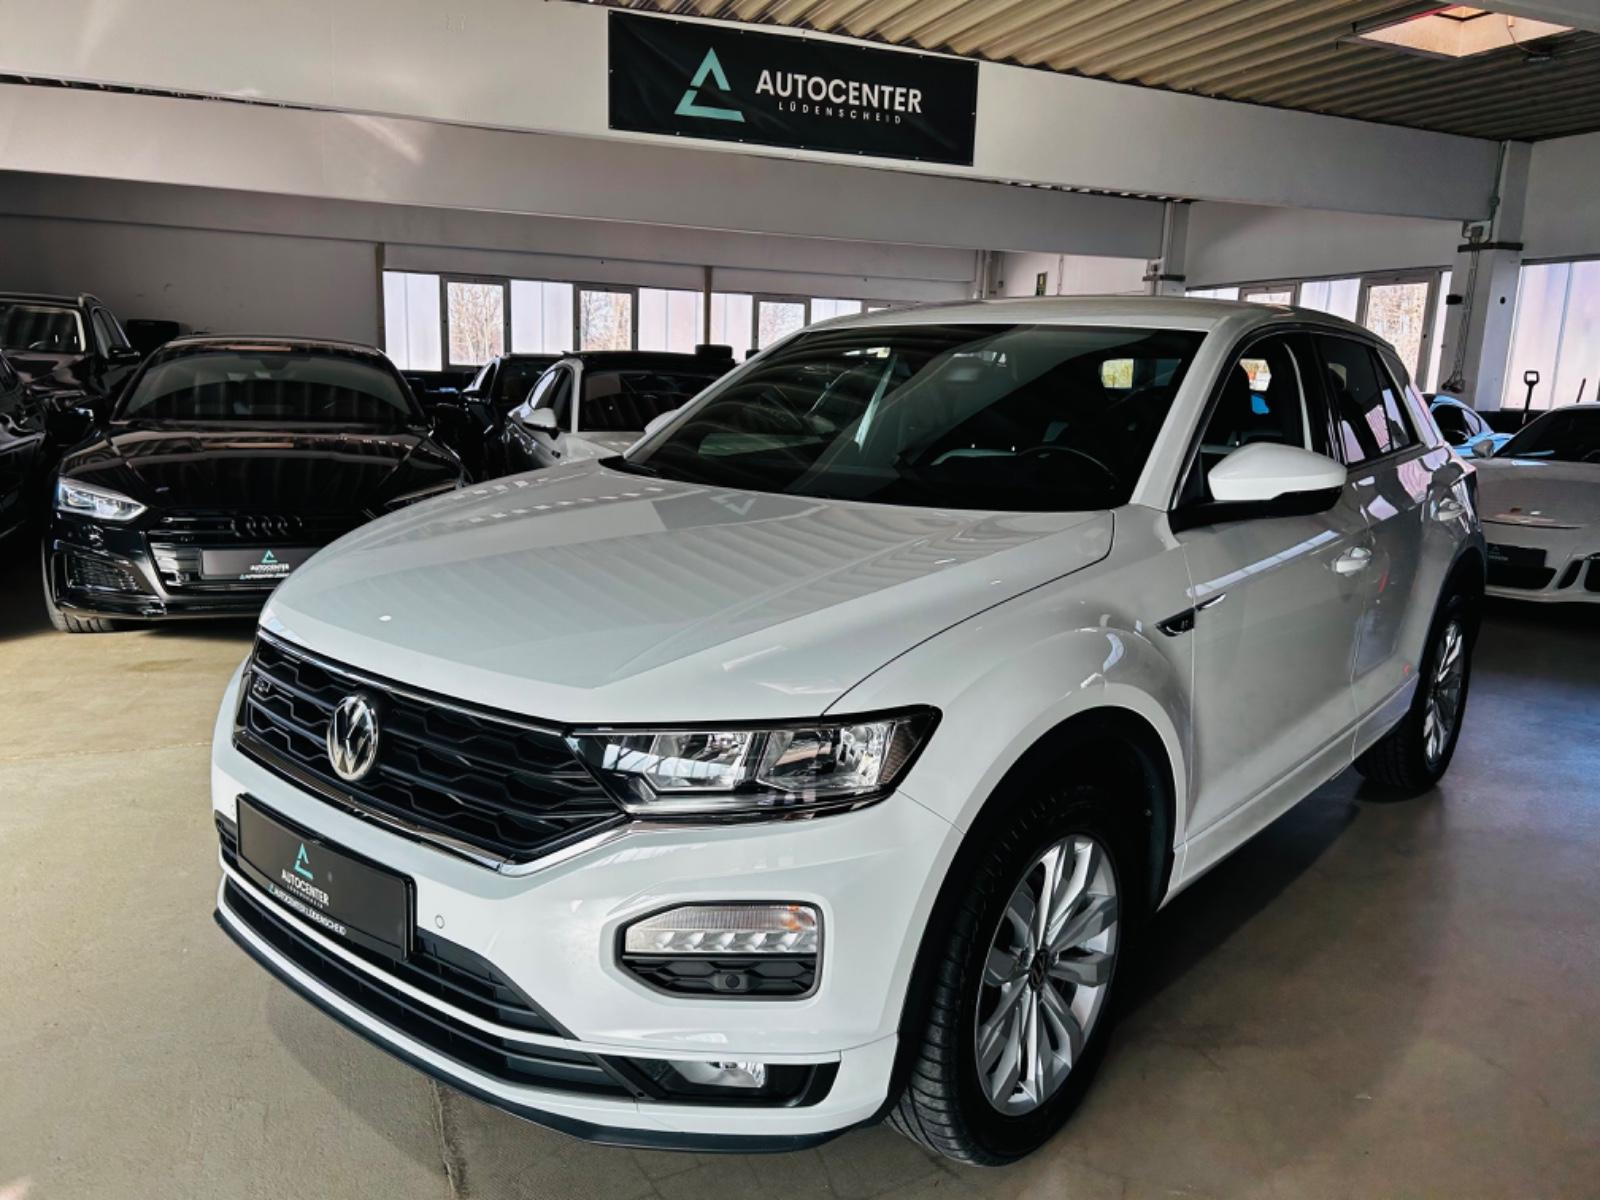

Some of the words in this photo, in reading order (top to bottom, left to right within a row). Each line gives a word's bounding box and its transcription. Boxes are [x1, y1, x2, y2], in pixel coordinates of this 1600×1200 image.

[755, 69, 922, 114] AUTOCENTER
[778, 101, 901, 125] LÜDENSCHEID
[281, 868, 330, 906] AUTOCENTER
